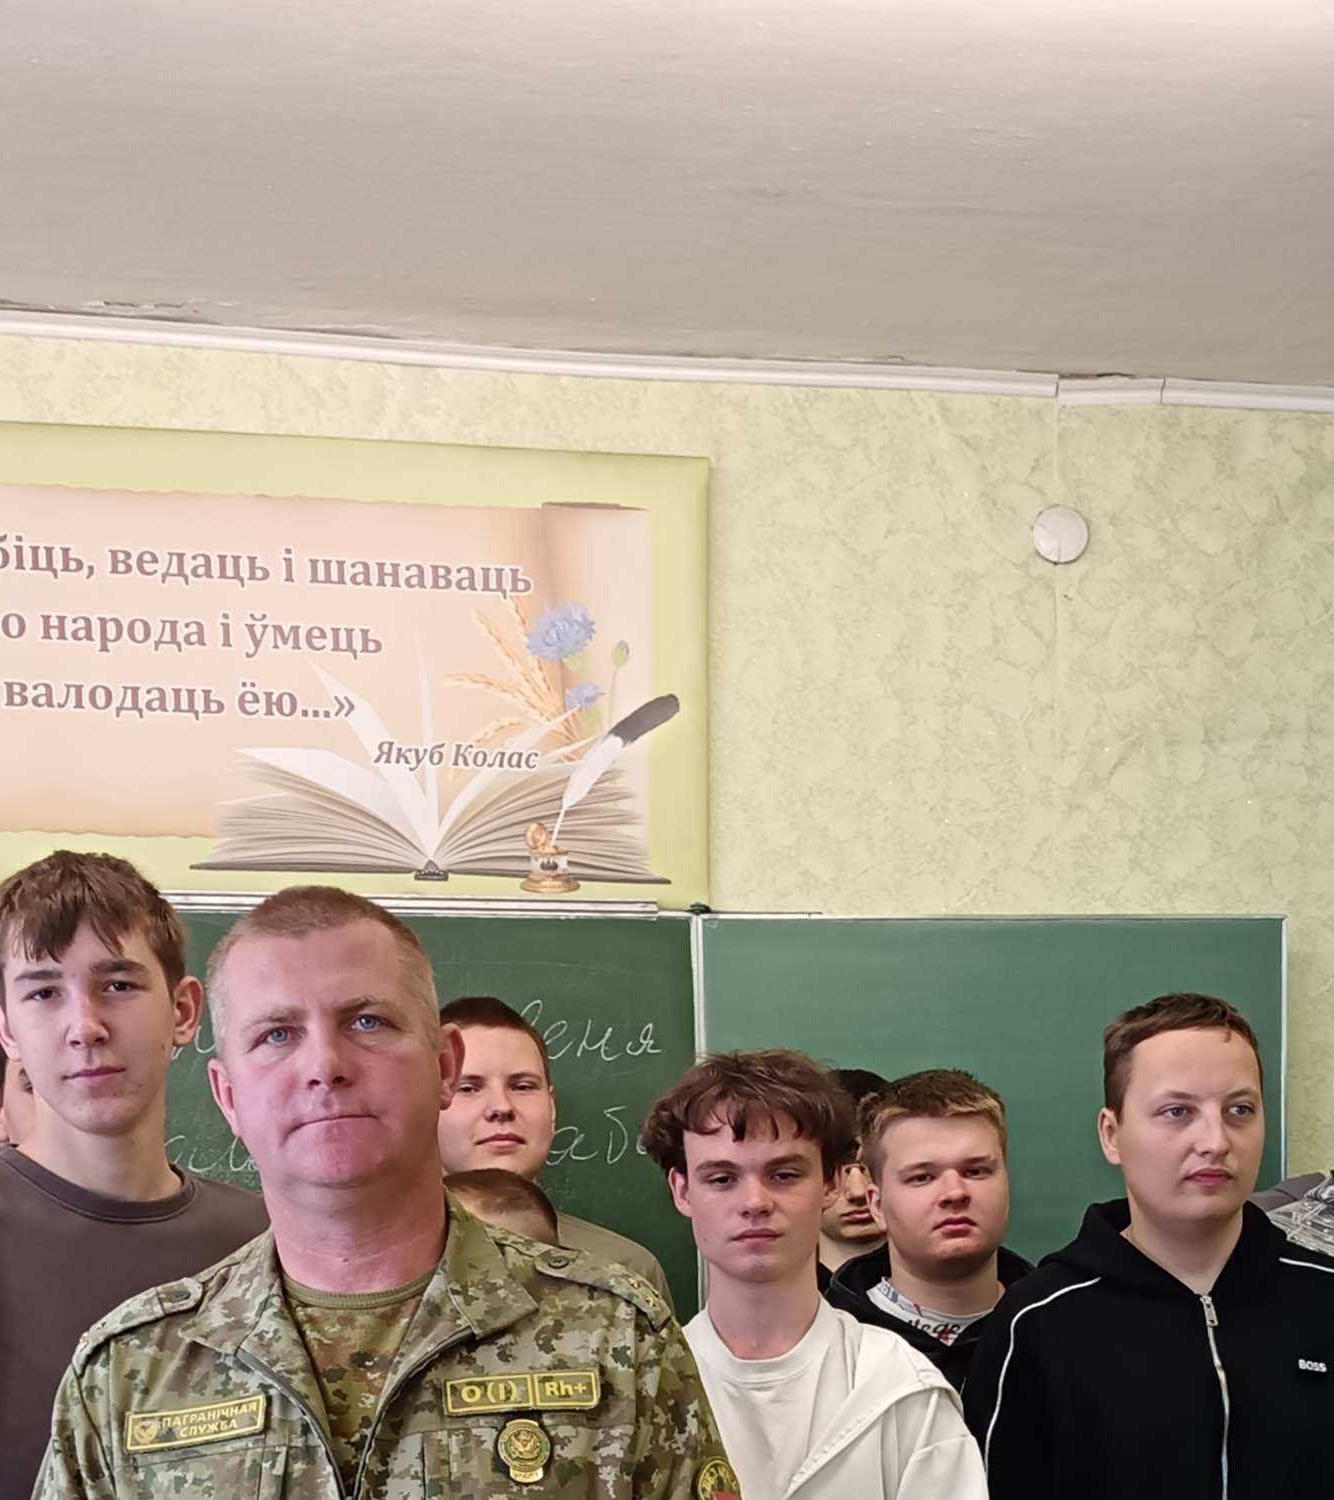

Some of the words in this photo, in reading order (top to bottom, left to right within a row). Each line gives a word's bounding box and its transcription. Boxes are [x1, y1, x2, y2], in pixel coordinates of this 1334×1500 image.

[108, 549, 270, 588] ведаць
[283, 547, 295, 583] і
[308, 558, 532, 600] шанаваць
[40, 614, 207, 653] народа
[220, 613, 233, 648] і
[244, 613, 383, 661] ўмець
[3, 681, 225, 721] валодаць
[237, 681, 355, 719] ёю...»
[373, 740, 446, 772] Якуб
[452, 743, 539, 769] Колас
[1297, 1358, 1328, 1373] BOSS
[544, 1381, 587, 1397] Rh+
[162, 1401, 258, 1429] ПАГРАНІЧНАЯ
[180, 1418, 239, 1438] СЛУЖБА
